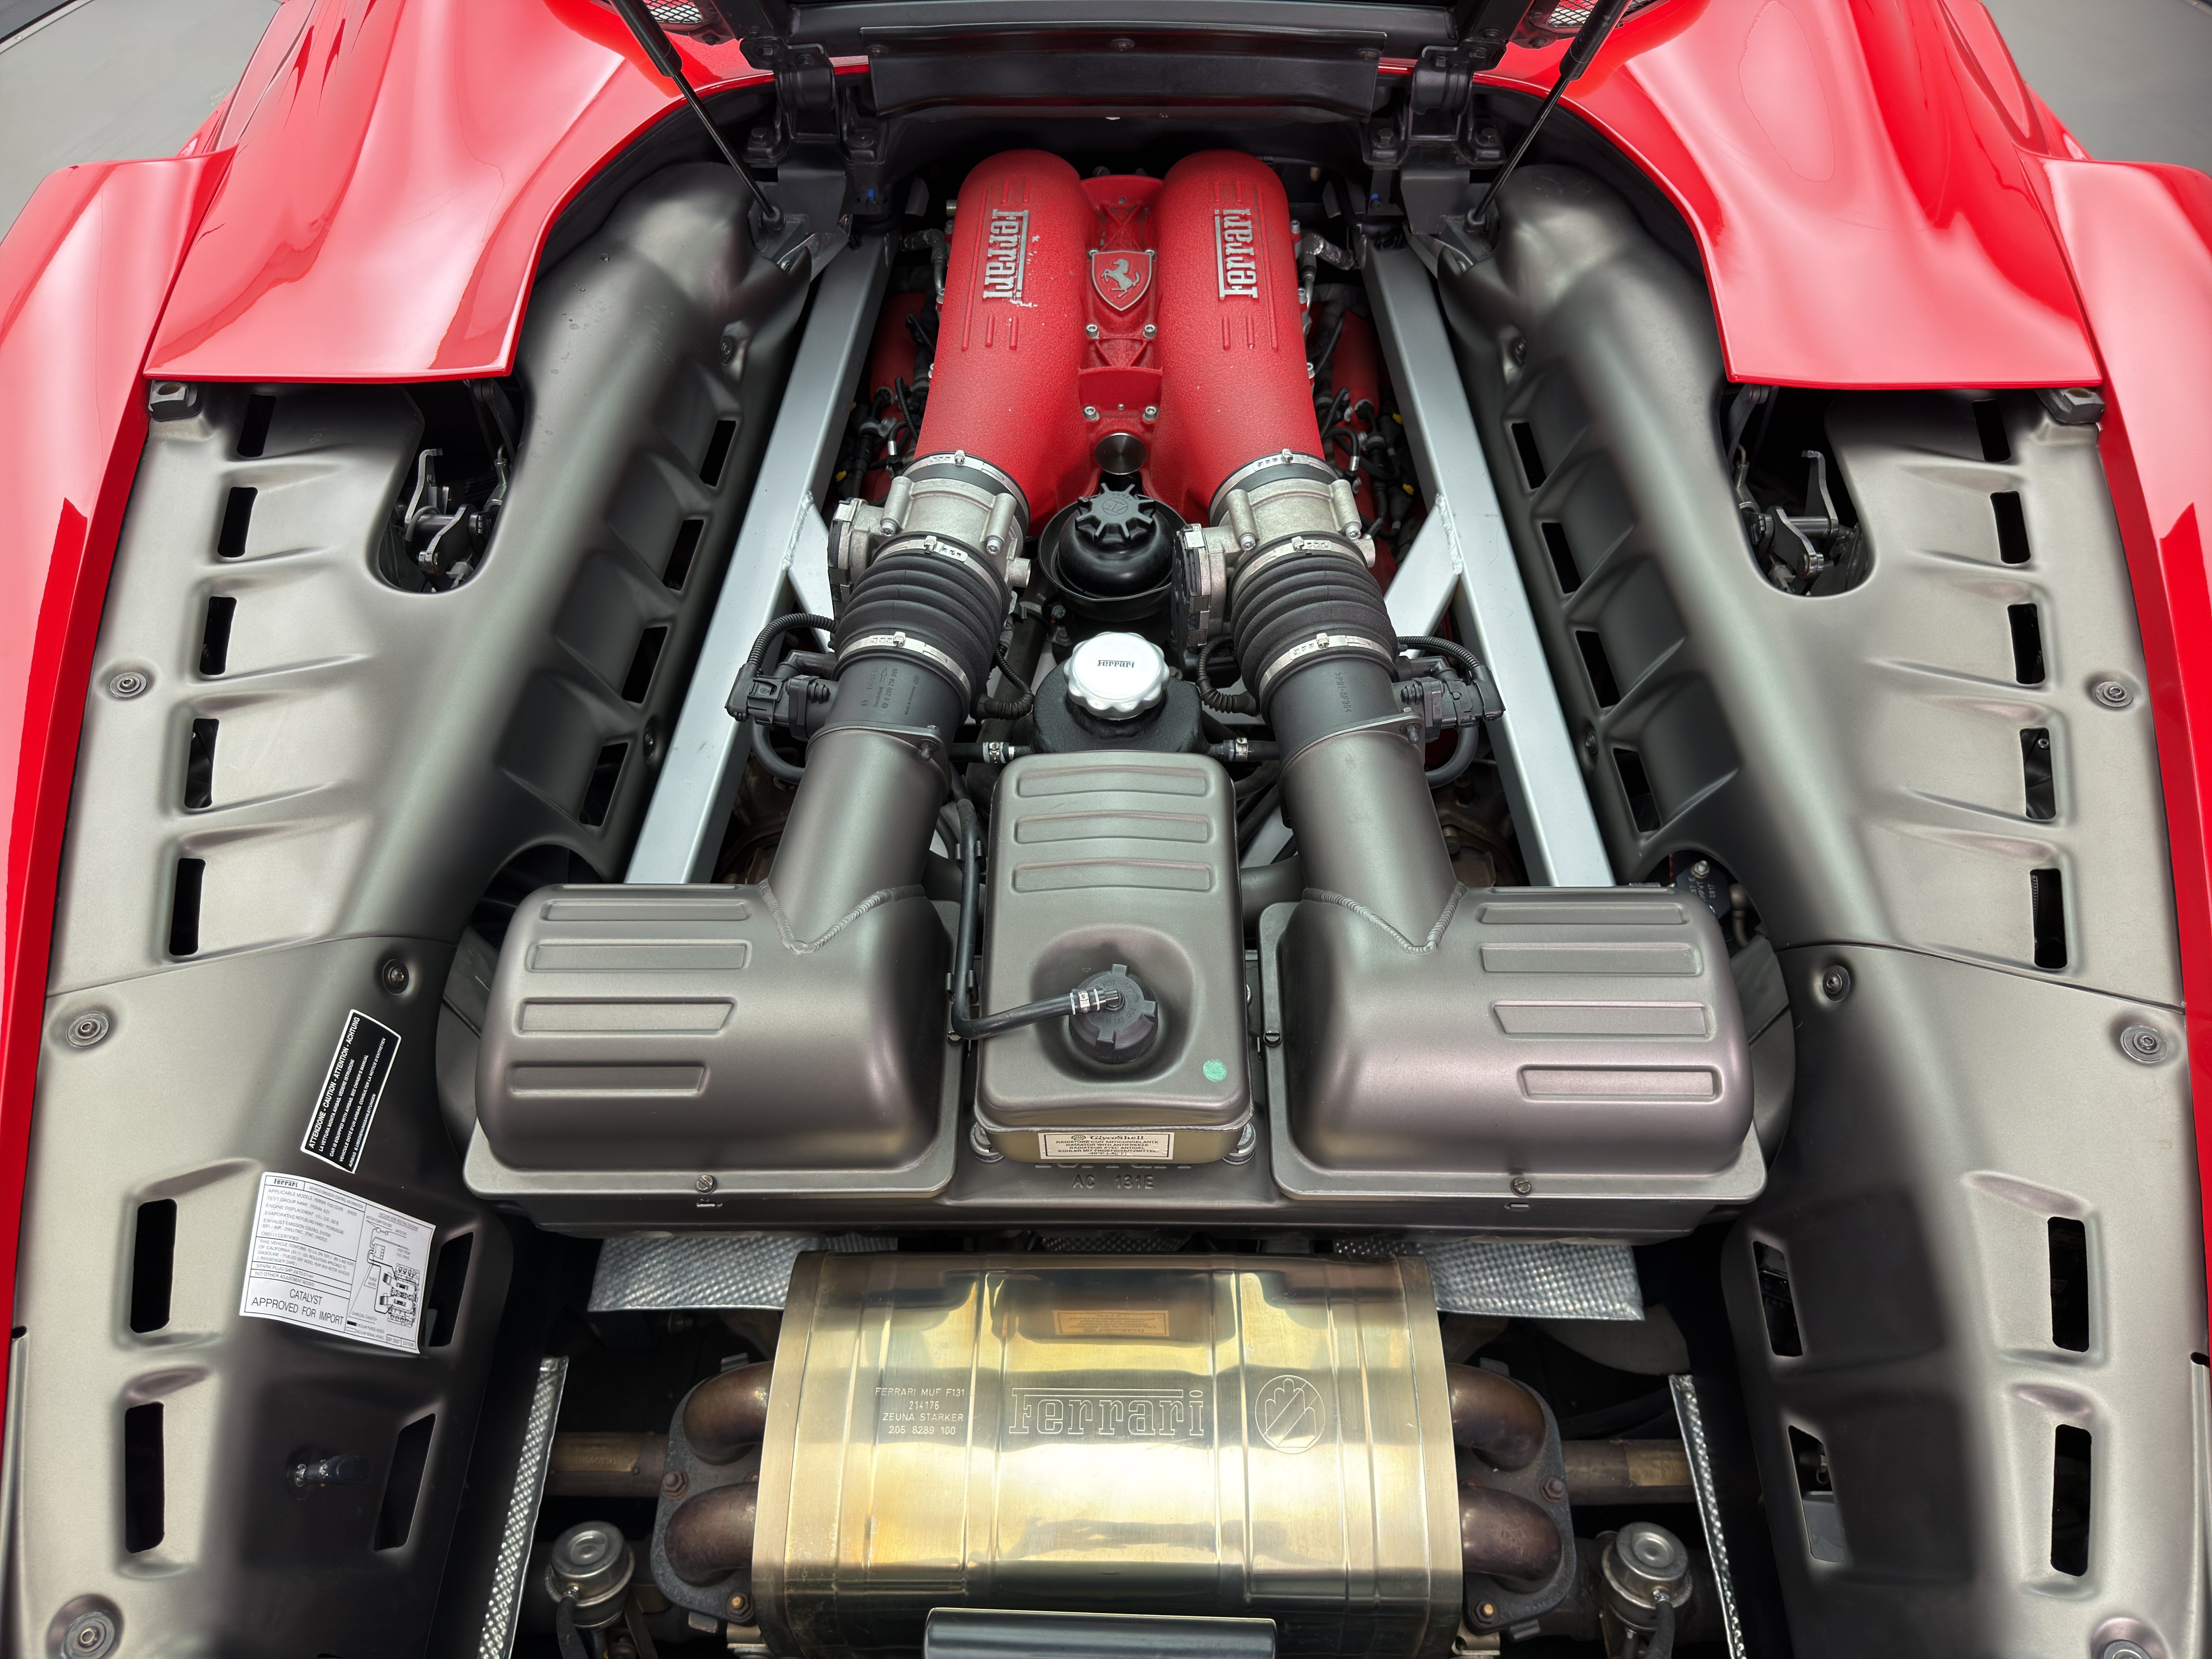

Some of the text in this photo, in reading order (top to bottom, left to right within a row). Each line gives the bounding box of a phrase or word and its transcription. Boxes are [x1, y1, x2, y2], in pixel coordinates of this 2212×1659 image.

[983, 209, 1029, 298] Ferrari
[1214, 209, 1258, 300] Ferrari
[1097, 660, 1134, 668] Ferrari
[1101, 980, 1116, 988] HOT
[308, 1017, 360, 1149] ATTENZIONE CAUTION ATTENTION ACHTUNG
[321, 1128, 331, 1147] VETTURA
[327, 1113, 336, 1128] MONTA
[333, 1097, 342, 1114] AIRBAG.
[338, 1080, 346, 1096] VEDERE
[344, 1059, 355, 1080] ISTRUZIONI
[334, 1123, 344, 1144] EQUIPPED
[345, 1097, 354, 1113] AIRBAG.
[353, 1070, 363, 1089] OWNER'S
[359, 1054, 369, 1071] MANUAL
[339, 1142, 349, 1162] VEHICULE
[353, 1105, 362, 1121] AIRBAG.
[359, 1081, 370, 1105] CONSULTER
[369, 1061, 377, 1077] NOTICE
[374, 1037, 386, 1062] D'ENTRETIEN
[349, 1152, 357, 1168] AIRBAG
[273, 1179, 298, 1187] Ferrari
[1073, 1174, 1154, 1189] AC 131E
[285, 1206, 313, 1216] DISPLACEMENT
[305, 1225, 319, 1233] CONTROL
[280, 1275, 302, 1283] ADJUSTMENT
[290, 1289, 323, 1305] CATALYST
[252, 1297, 344, 1325] APPROVED FOR IMPORT
[875, 1387, 965, 1397] FERRARI MUF F131
[909, 1400, 939, 1410] 214176
[1009, 1387, 1204, 1435] Ferrari
[882, 1412, 915, 1421] ZEUNA
[888, 1426, 956, 1435] 205 8289 100
